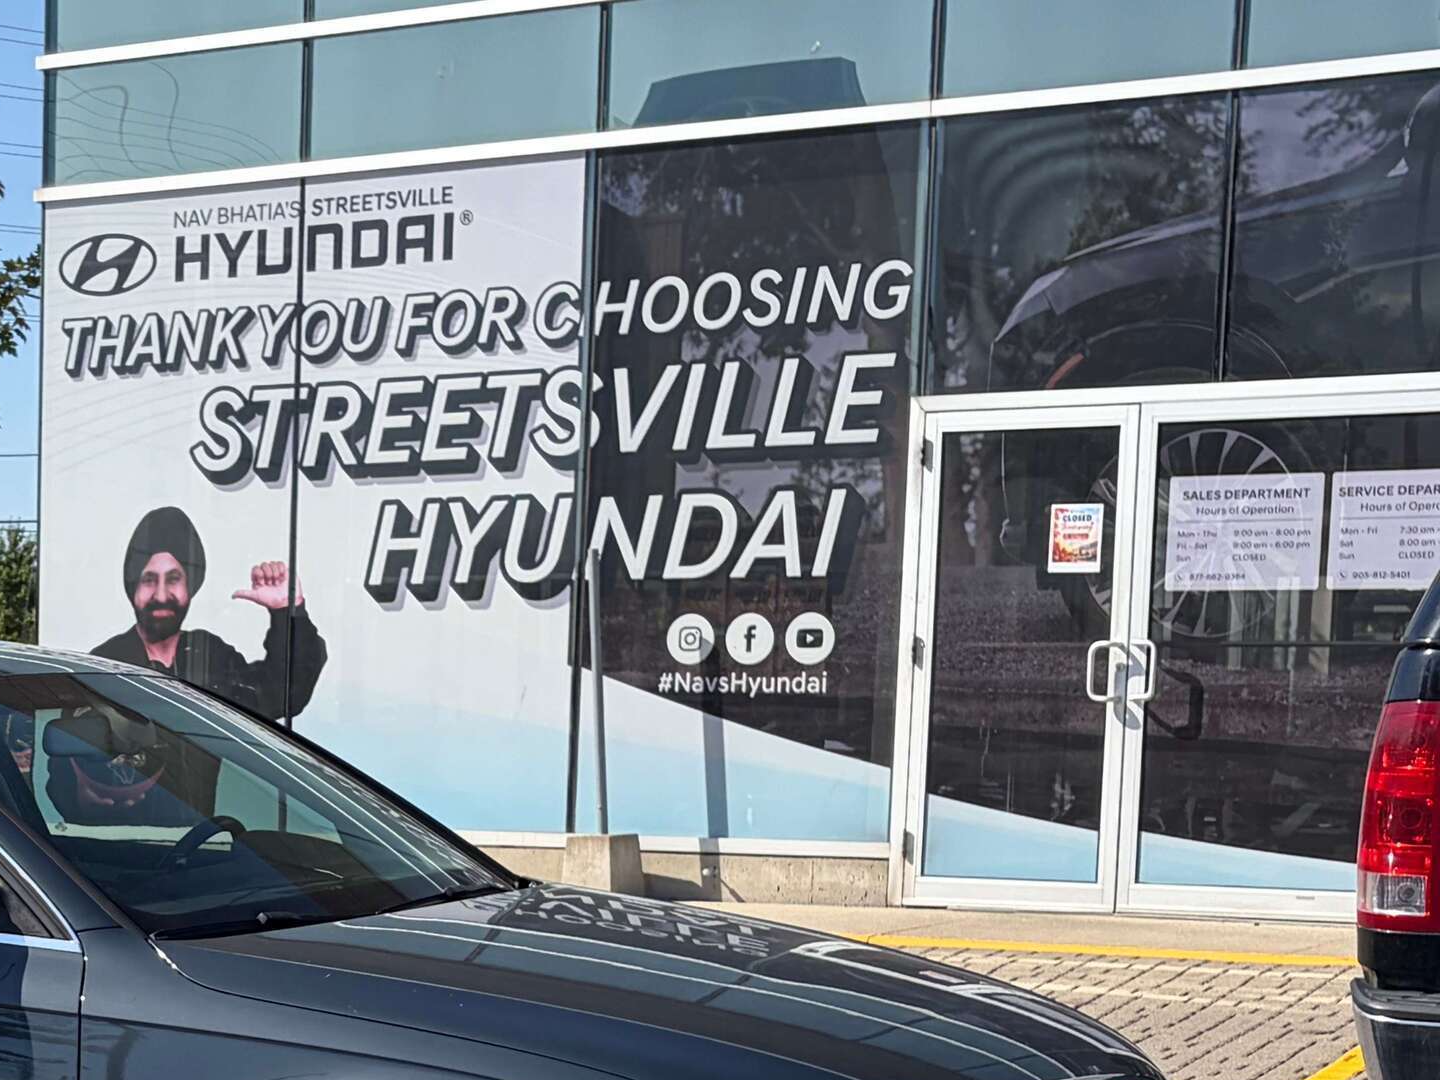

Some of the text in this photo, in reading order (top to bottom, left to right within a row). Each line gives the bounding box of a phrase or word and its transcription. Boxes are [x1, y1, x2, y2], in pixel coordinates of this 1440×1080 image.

[173, 186, 454, 229] NAV BHATIA'S STREETSVILLE
[62, 259, 913, 379] THANK YOU FOR CHOOSING
[189, 351, 898, 486] STREETSVILLE
[1183, 487, 1311, 501] SALES DEPARTMENT
[1338, 485, 1394, 497] SERVICE
[1195, 505, 1227, 516] Hours
[1241, 504, 1295, 516] Operation
[1360, 502, 1393, 512] Hours
[1395, 501, 1406, 511] of
[364, 486, 858, 604] HYUNDAI
[1231, 553, 1267, 562] CLOSED
[1398, 551, 1435, 560] CLOSED
[657, 671, 828, 699] #NavsHyundai
